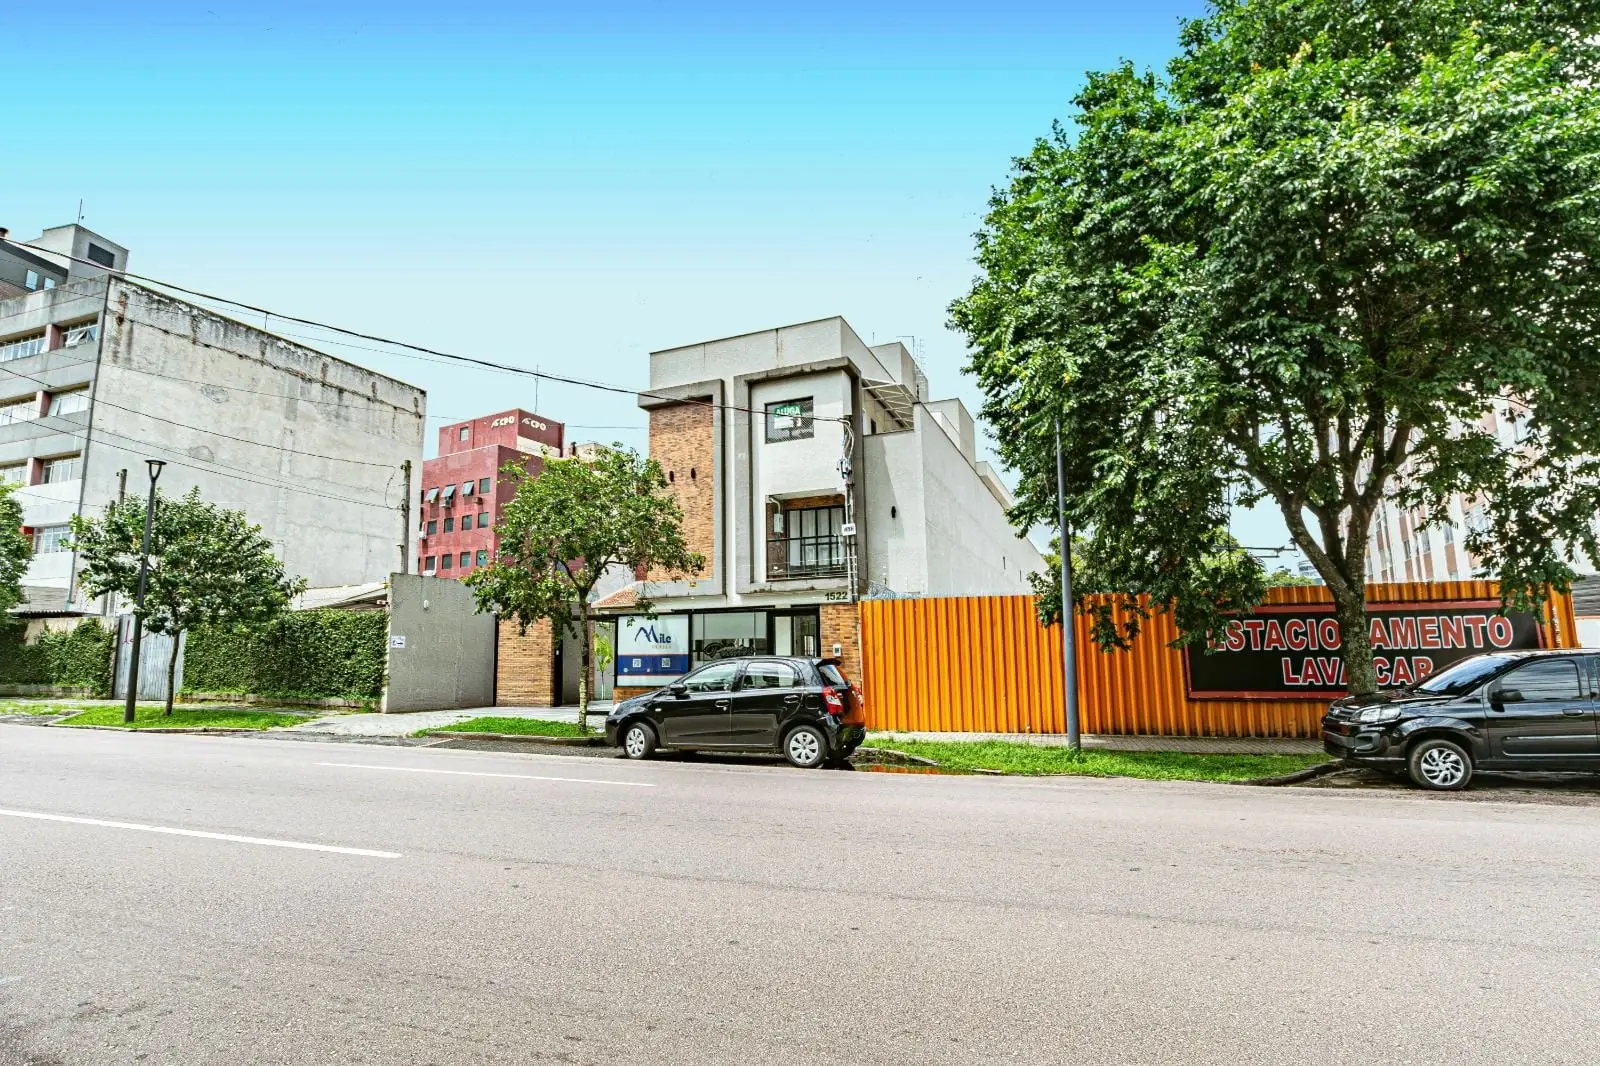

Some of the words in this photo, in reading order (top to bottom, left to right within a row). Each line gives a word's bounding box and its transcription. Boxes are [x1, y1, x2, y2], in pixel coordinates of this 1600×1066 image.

[776, 406, 800, 417] ALUGA
[825, 592, 848, 601] 1522
[635, 624, 672, 643] Mile
[1206, 615, 1514, 651] STACIOAMENTO
